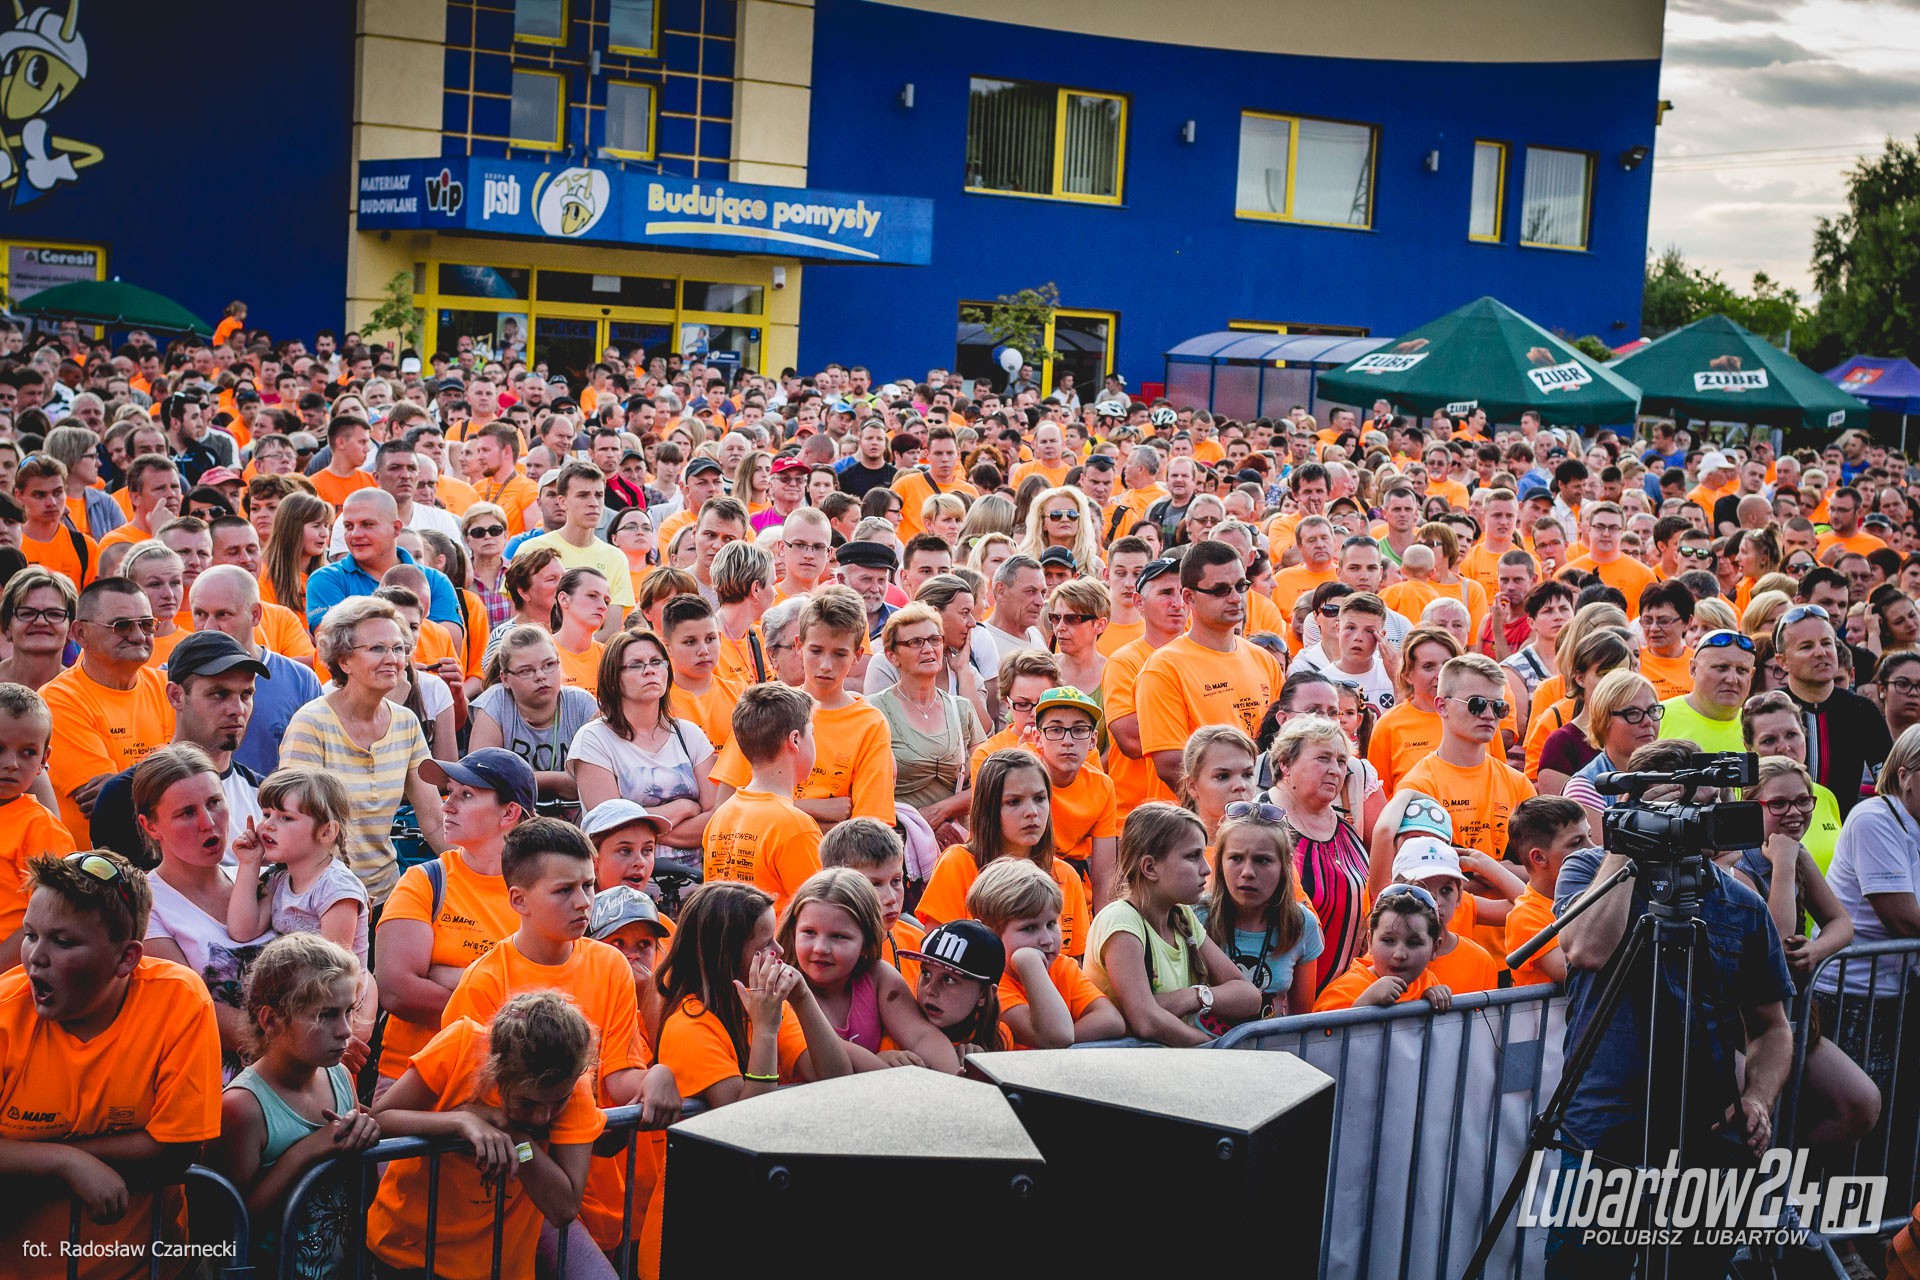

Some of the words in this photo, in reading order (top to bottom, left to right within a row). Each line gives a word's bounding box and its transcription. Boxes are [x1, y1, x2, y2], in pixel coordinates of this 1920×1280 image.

[361, 175, 410, 191] MATERIAŁY
[483, 174, 521, 220] psb
[360, 197, 417, 214] BUDOWLANE
[648, 183, 768, 224] Budujące
[773, 199, 882, 237] pomysły
[40, 249, 95, 265] Ceresit
[1359, 353, 1416, 370] ŻUBR
[1534, 364, 1587, 386] ŻUBR
[1700, 373, 1762, 386] ŻUBR
[452, 915, 476, 926] MAPEI
[21, 1111, 57, 1123] MAPEI
